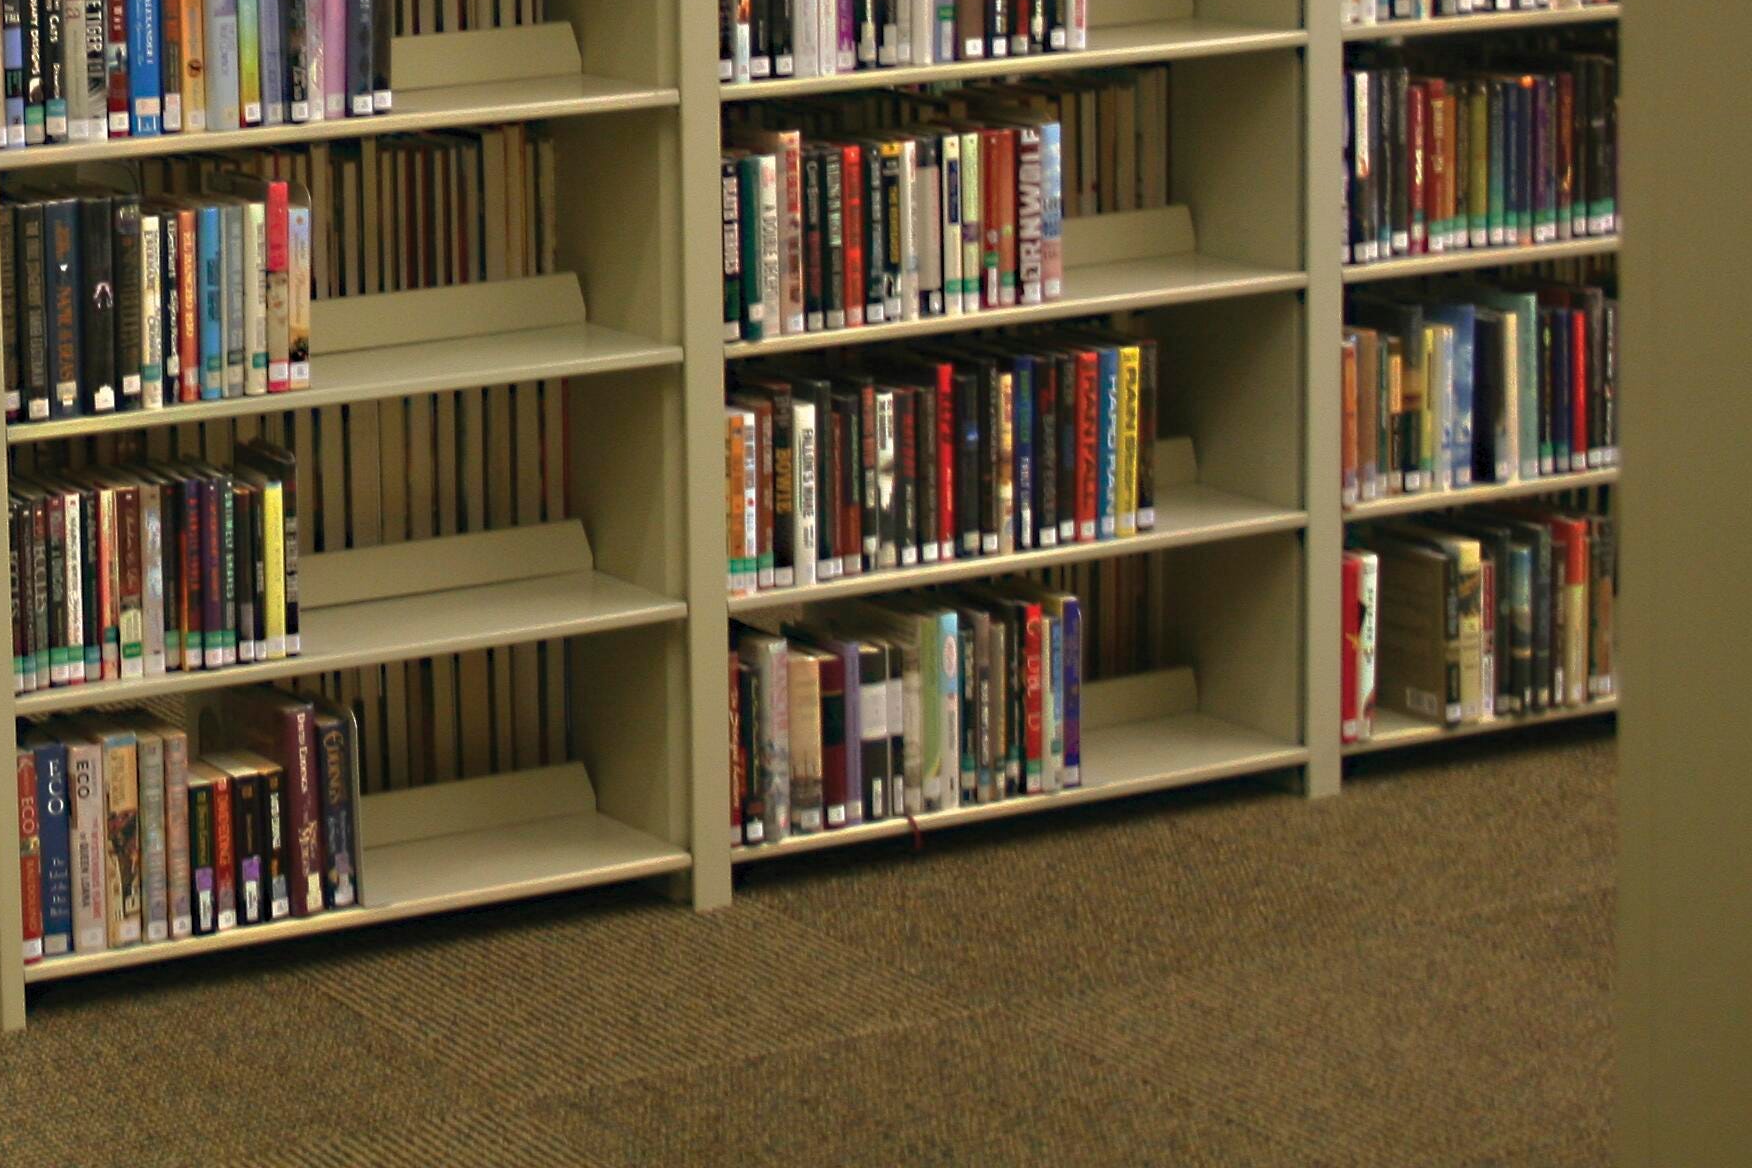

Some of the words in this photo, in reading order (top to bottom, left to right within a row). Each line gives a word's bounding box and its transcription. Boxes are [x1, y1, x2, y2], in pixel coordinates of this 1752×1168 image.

[87, 12, 103, 53] TIGER
[76, 760, 91, 800] ECO
[21, 796, 36, 834] ECO
[79, 842, 90, 875] QUEEN
